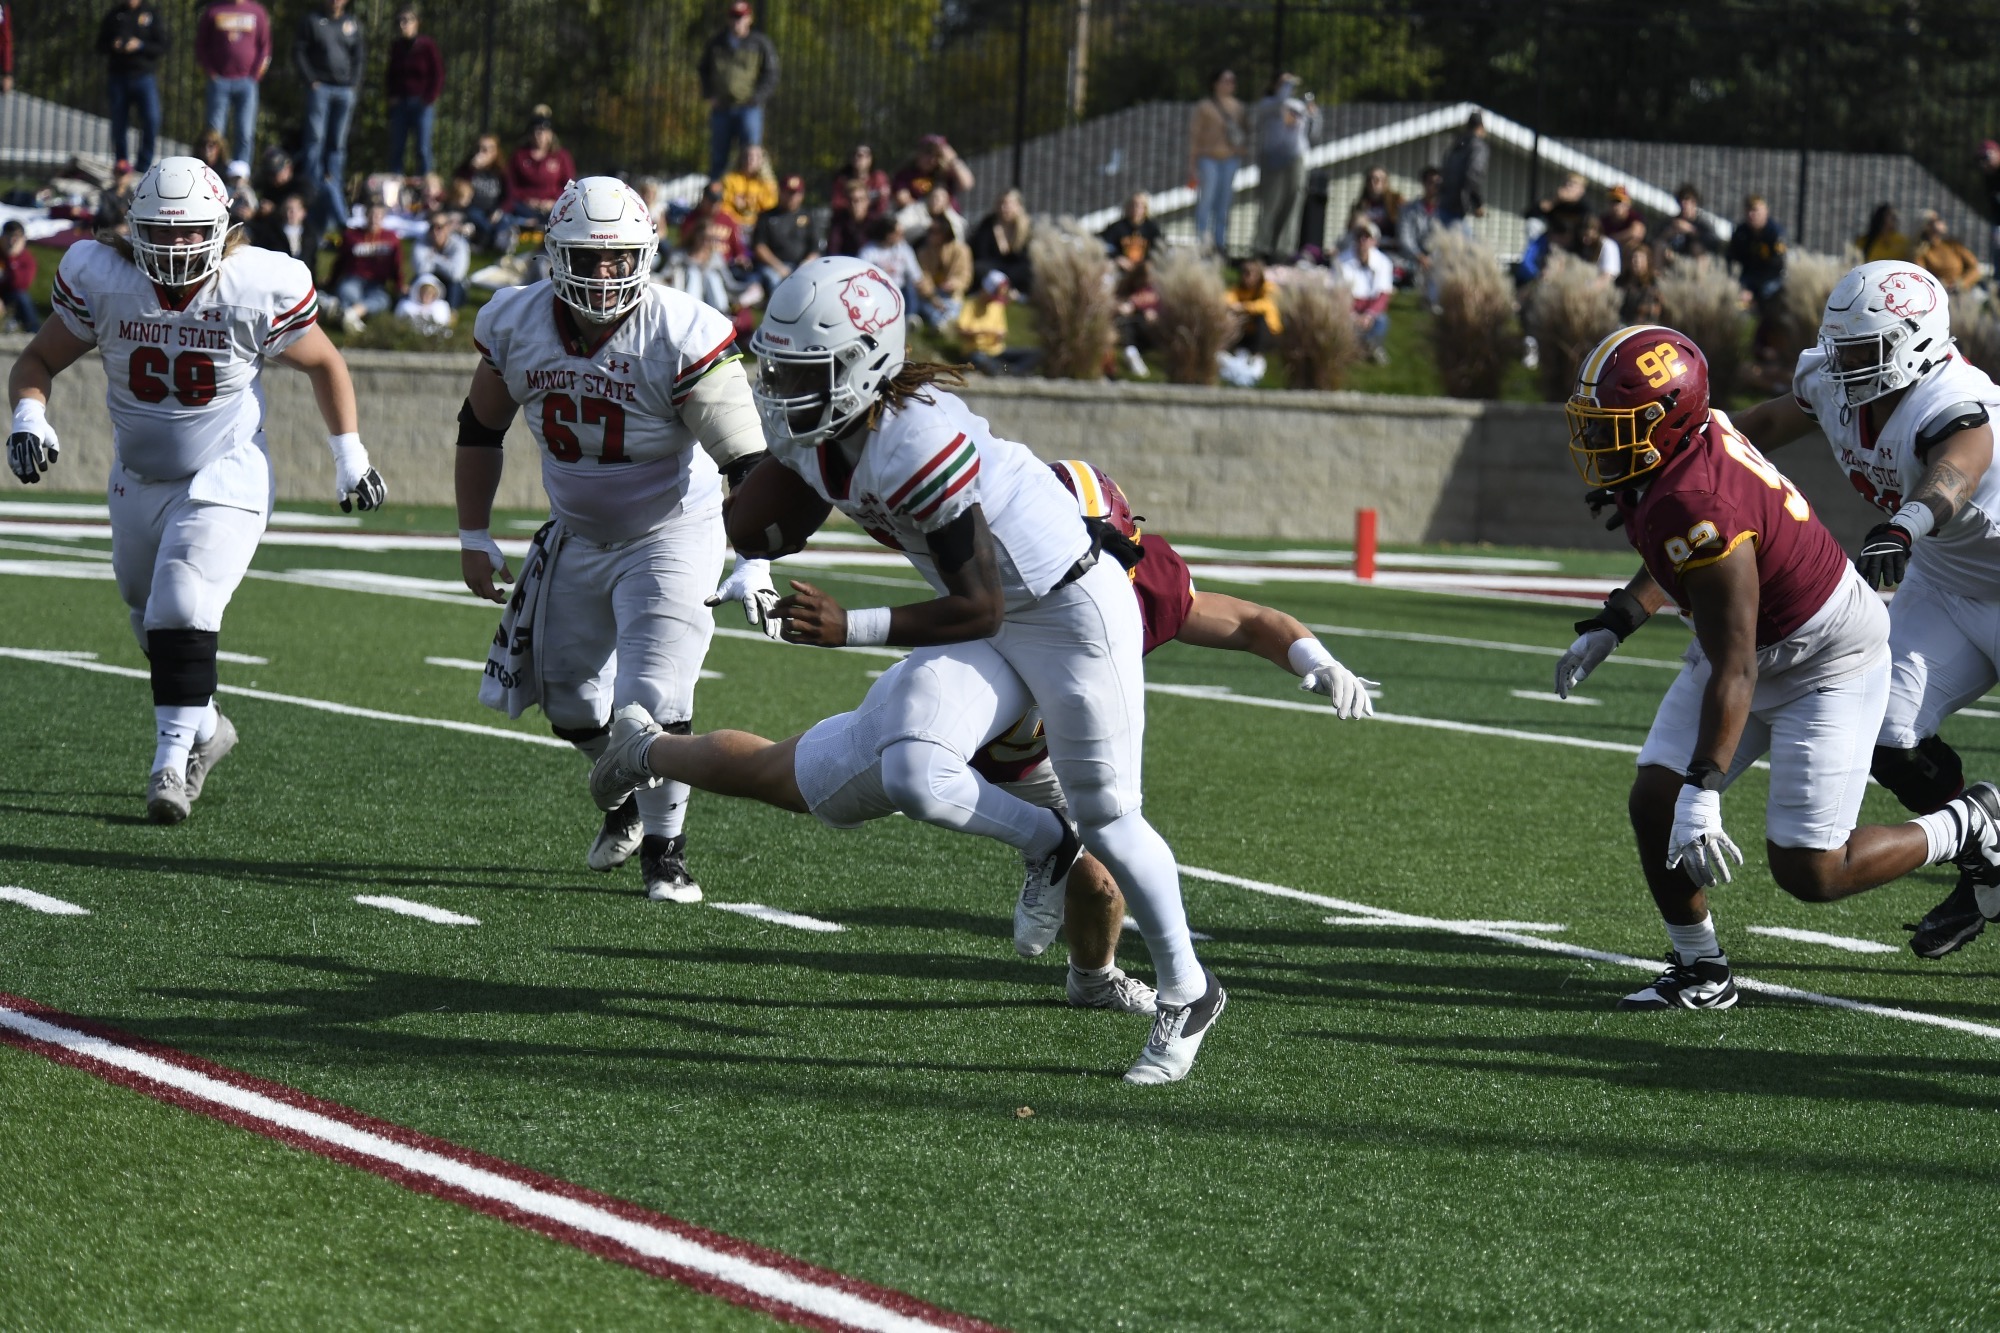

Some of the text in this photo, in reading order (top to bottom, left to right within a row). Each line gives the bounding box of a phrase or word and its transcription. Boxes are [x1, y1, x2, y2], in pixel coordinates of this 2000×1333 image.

[119, 320, 227, 349] MINOT STATE
[128, 345, 217, 407] 69
[525, 369, 636, 402] MINOT STATE
[1635, 342, 1688, 389] 92
[541, 392, 632, 465] 67
